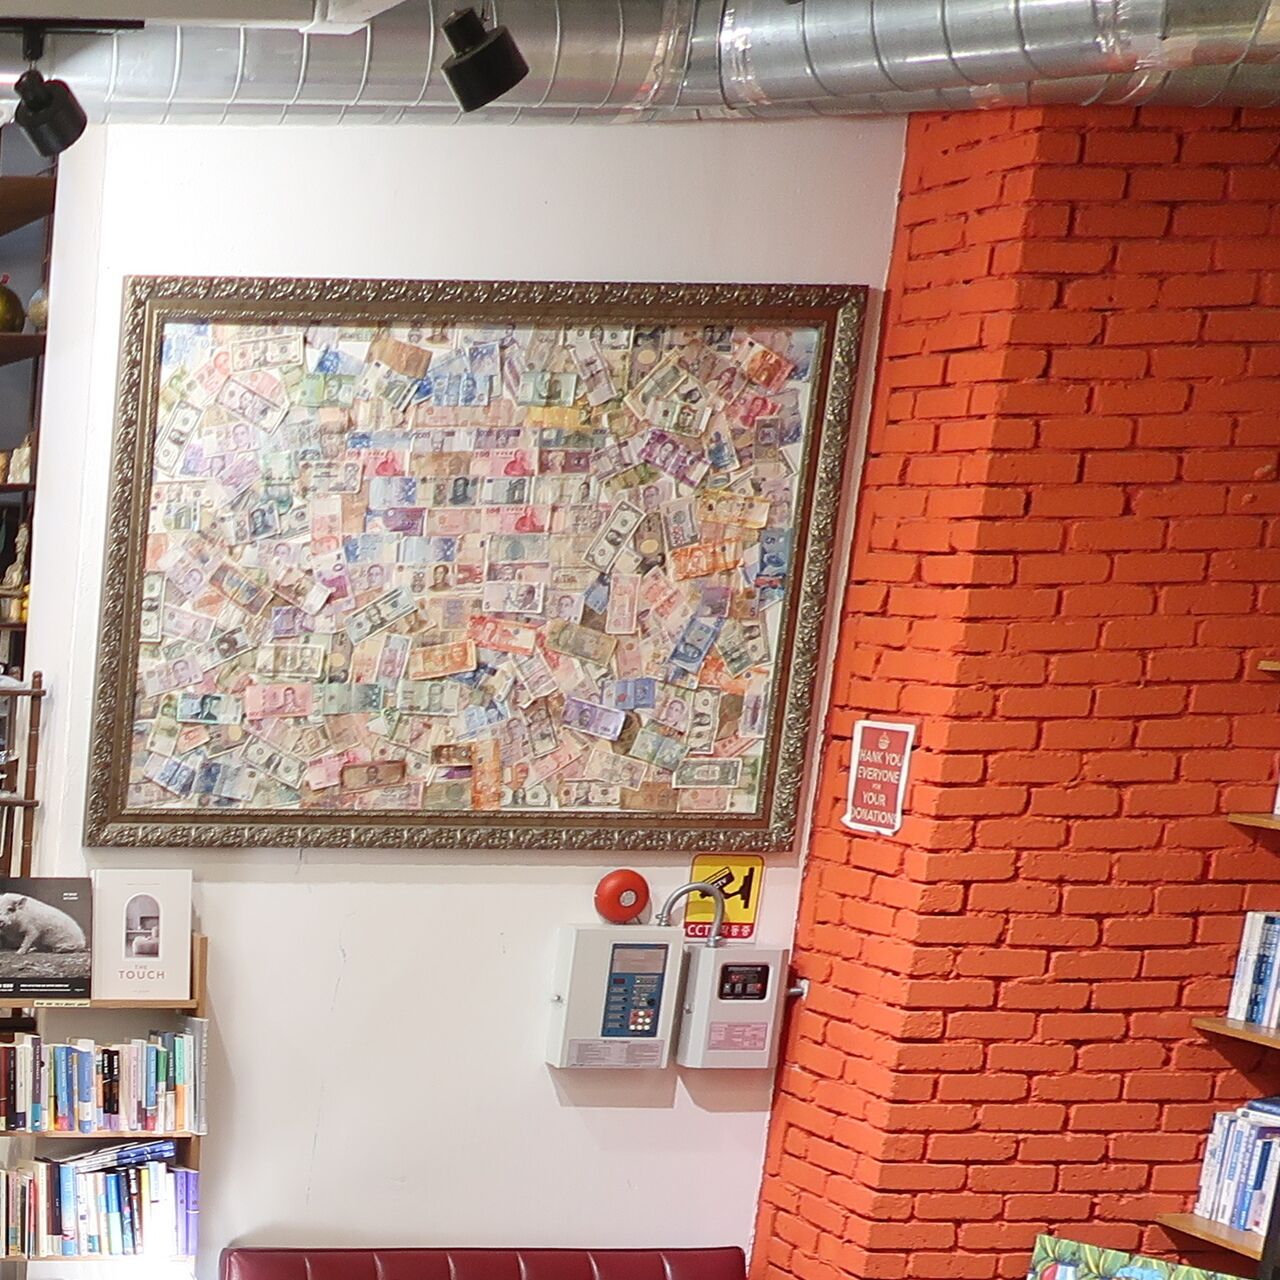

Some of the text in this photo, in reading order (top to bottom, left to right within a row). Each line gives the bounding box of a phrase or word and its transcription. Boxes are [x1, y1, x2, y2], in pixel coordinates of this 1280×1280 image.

[859, 749, 884, 764] HANK
[858, 766, 900, 784] EVERYONE
[862, 791, 886, 807] YOUR
[687, 925, 712, 937] CCT
[118, 970, 166, 981] TOUCH
